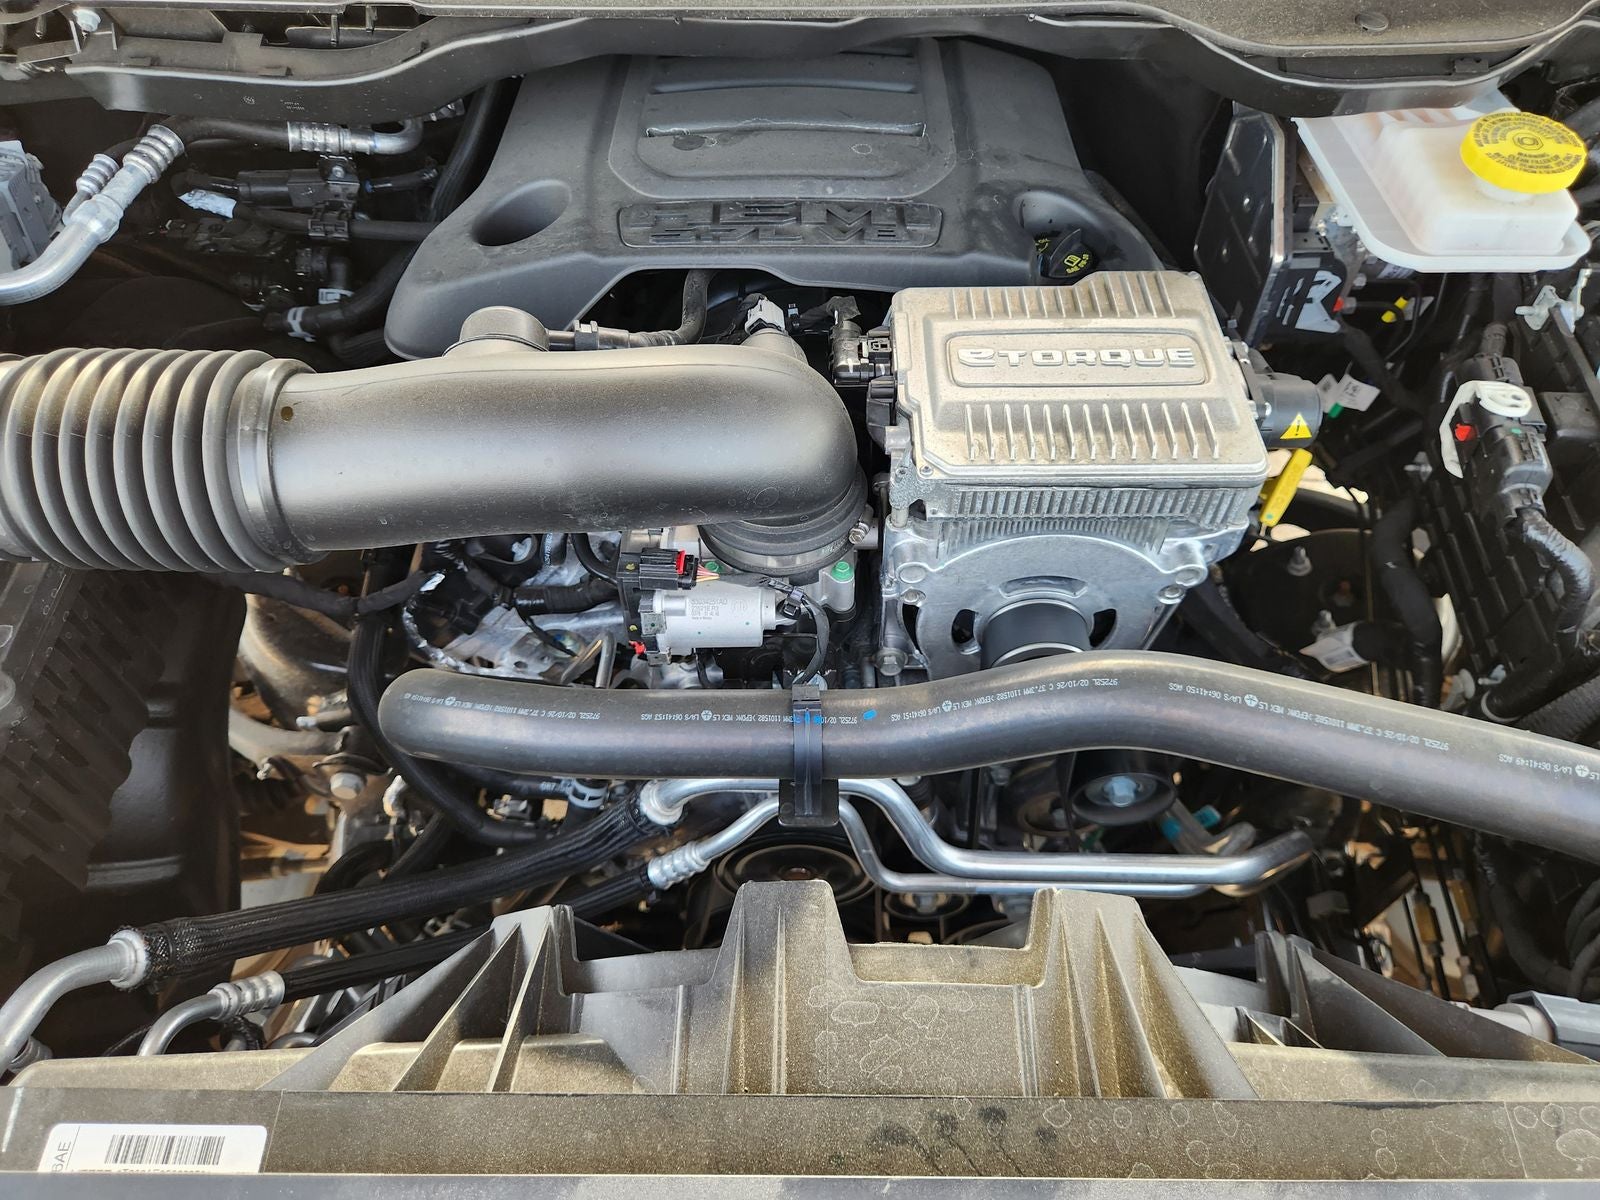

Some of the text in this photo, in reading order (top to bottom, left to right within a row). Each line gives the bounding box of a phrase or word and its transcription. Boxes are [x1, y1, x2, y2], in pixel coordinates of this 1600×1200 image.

[1056, 679, 1089, 689] 02/10/26
[1092, 678, 1118, 687] 97252L
[722, 714, 733, 722] MEX
